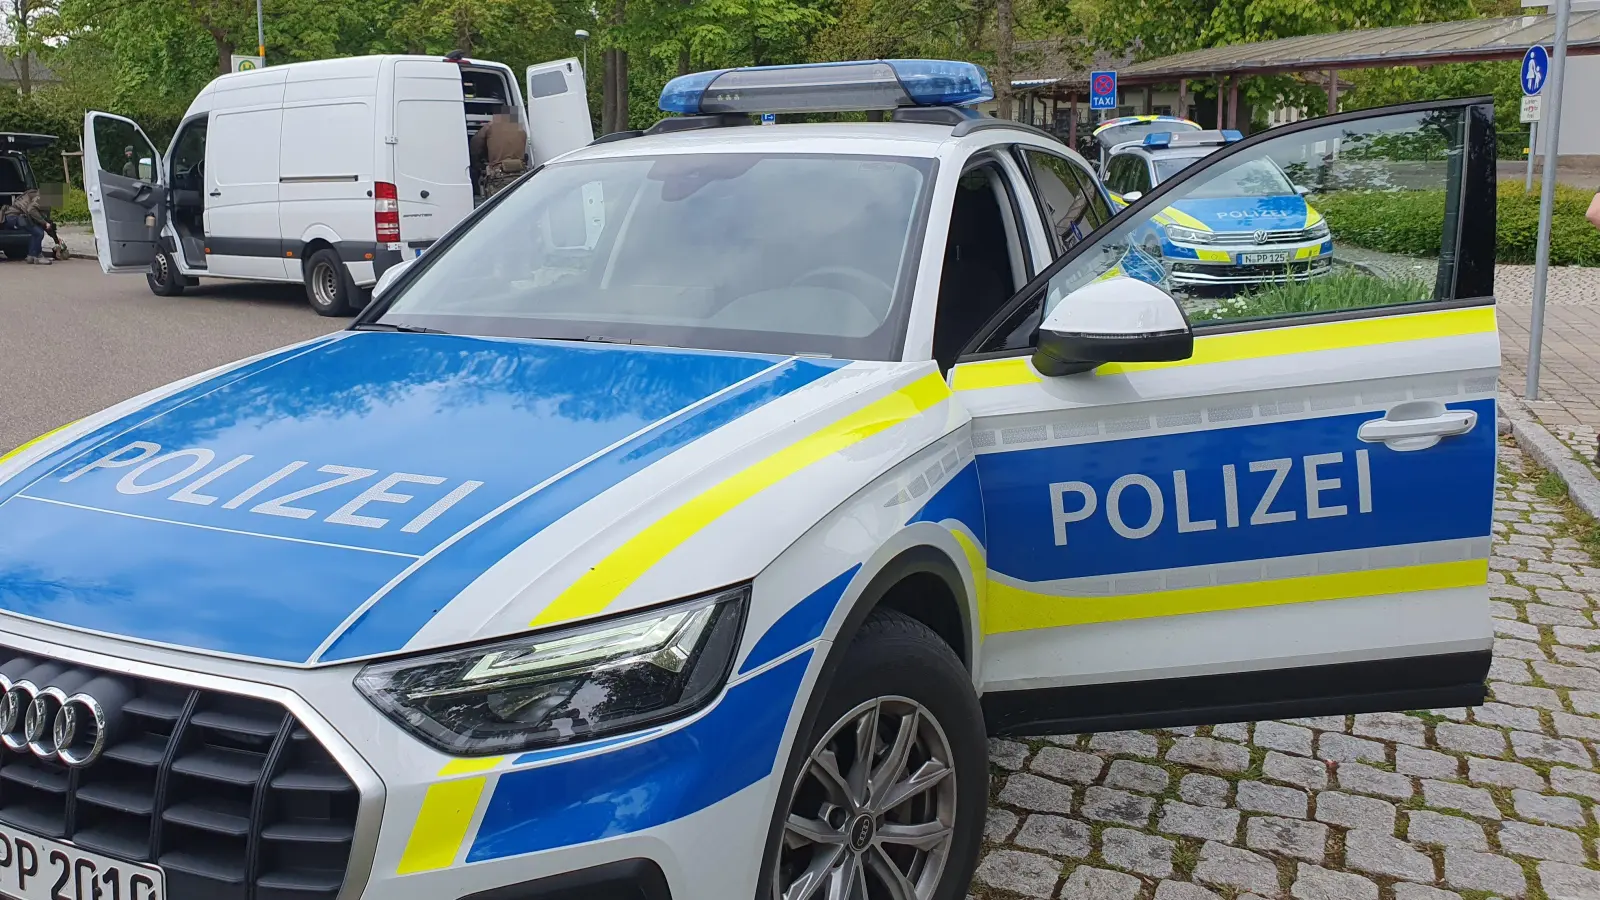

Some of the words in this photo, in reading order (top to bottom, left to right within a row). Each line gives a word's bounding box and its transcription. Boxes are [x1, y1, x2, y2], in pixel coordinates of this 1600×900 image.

[1093, 96, 1114, 106] TAXI
[1216, 209, 1288, 219] POLIZEI
[1245, 255, 1252, 263] N
[1257, 255, 1268, 263] PP
[1270, 253, 1285, 262] 125
[60, 440, 485, 534] POLIZEI
[1049, 448, 1373, 546] POLIZEI
[50, 849, 156, 900] 2010
